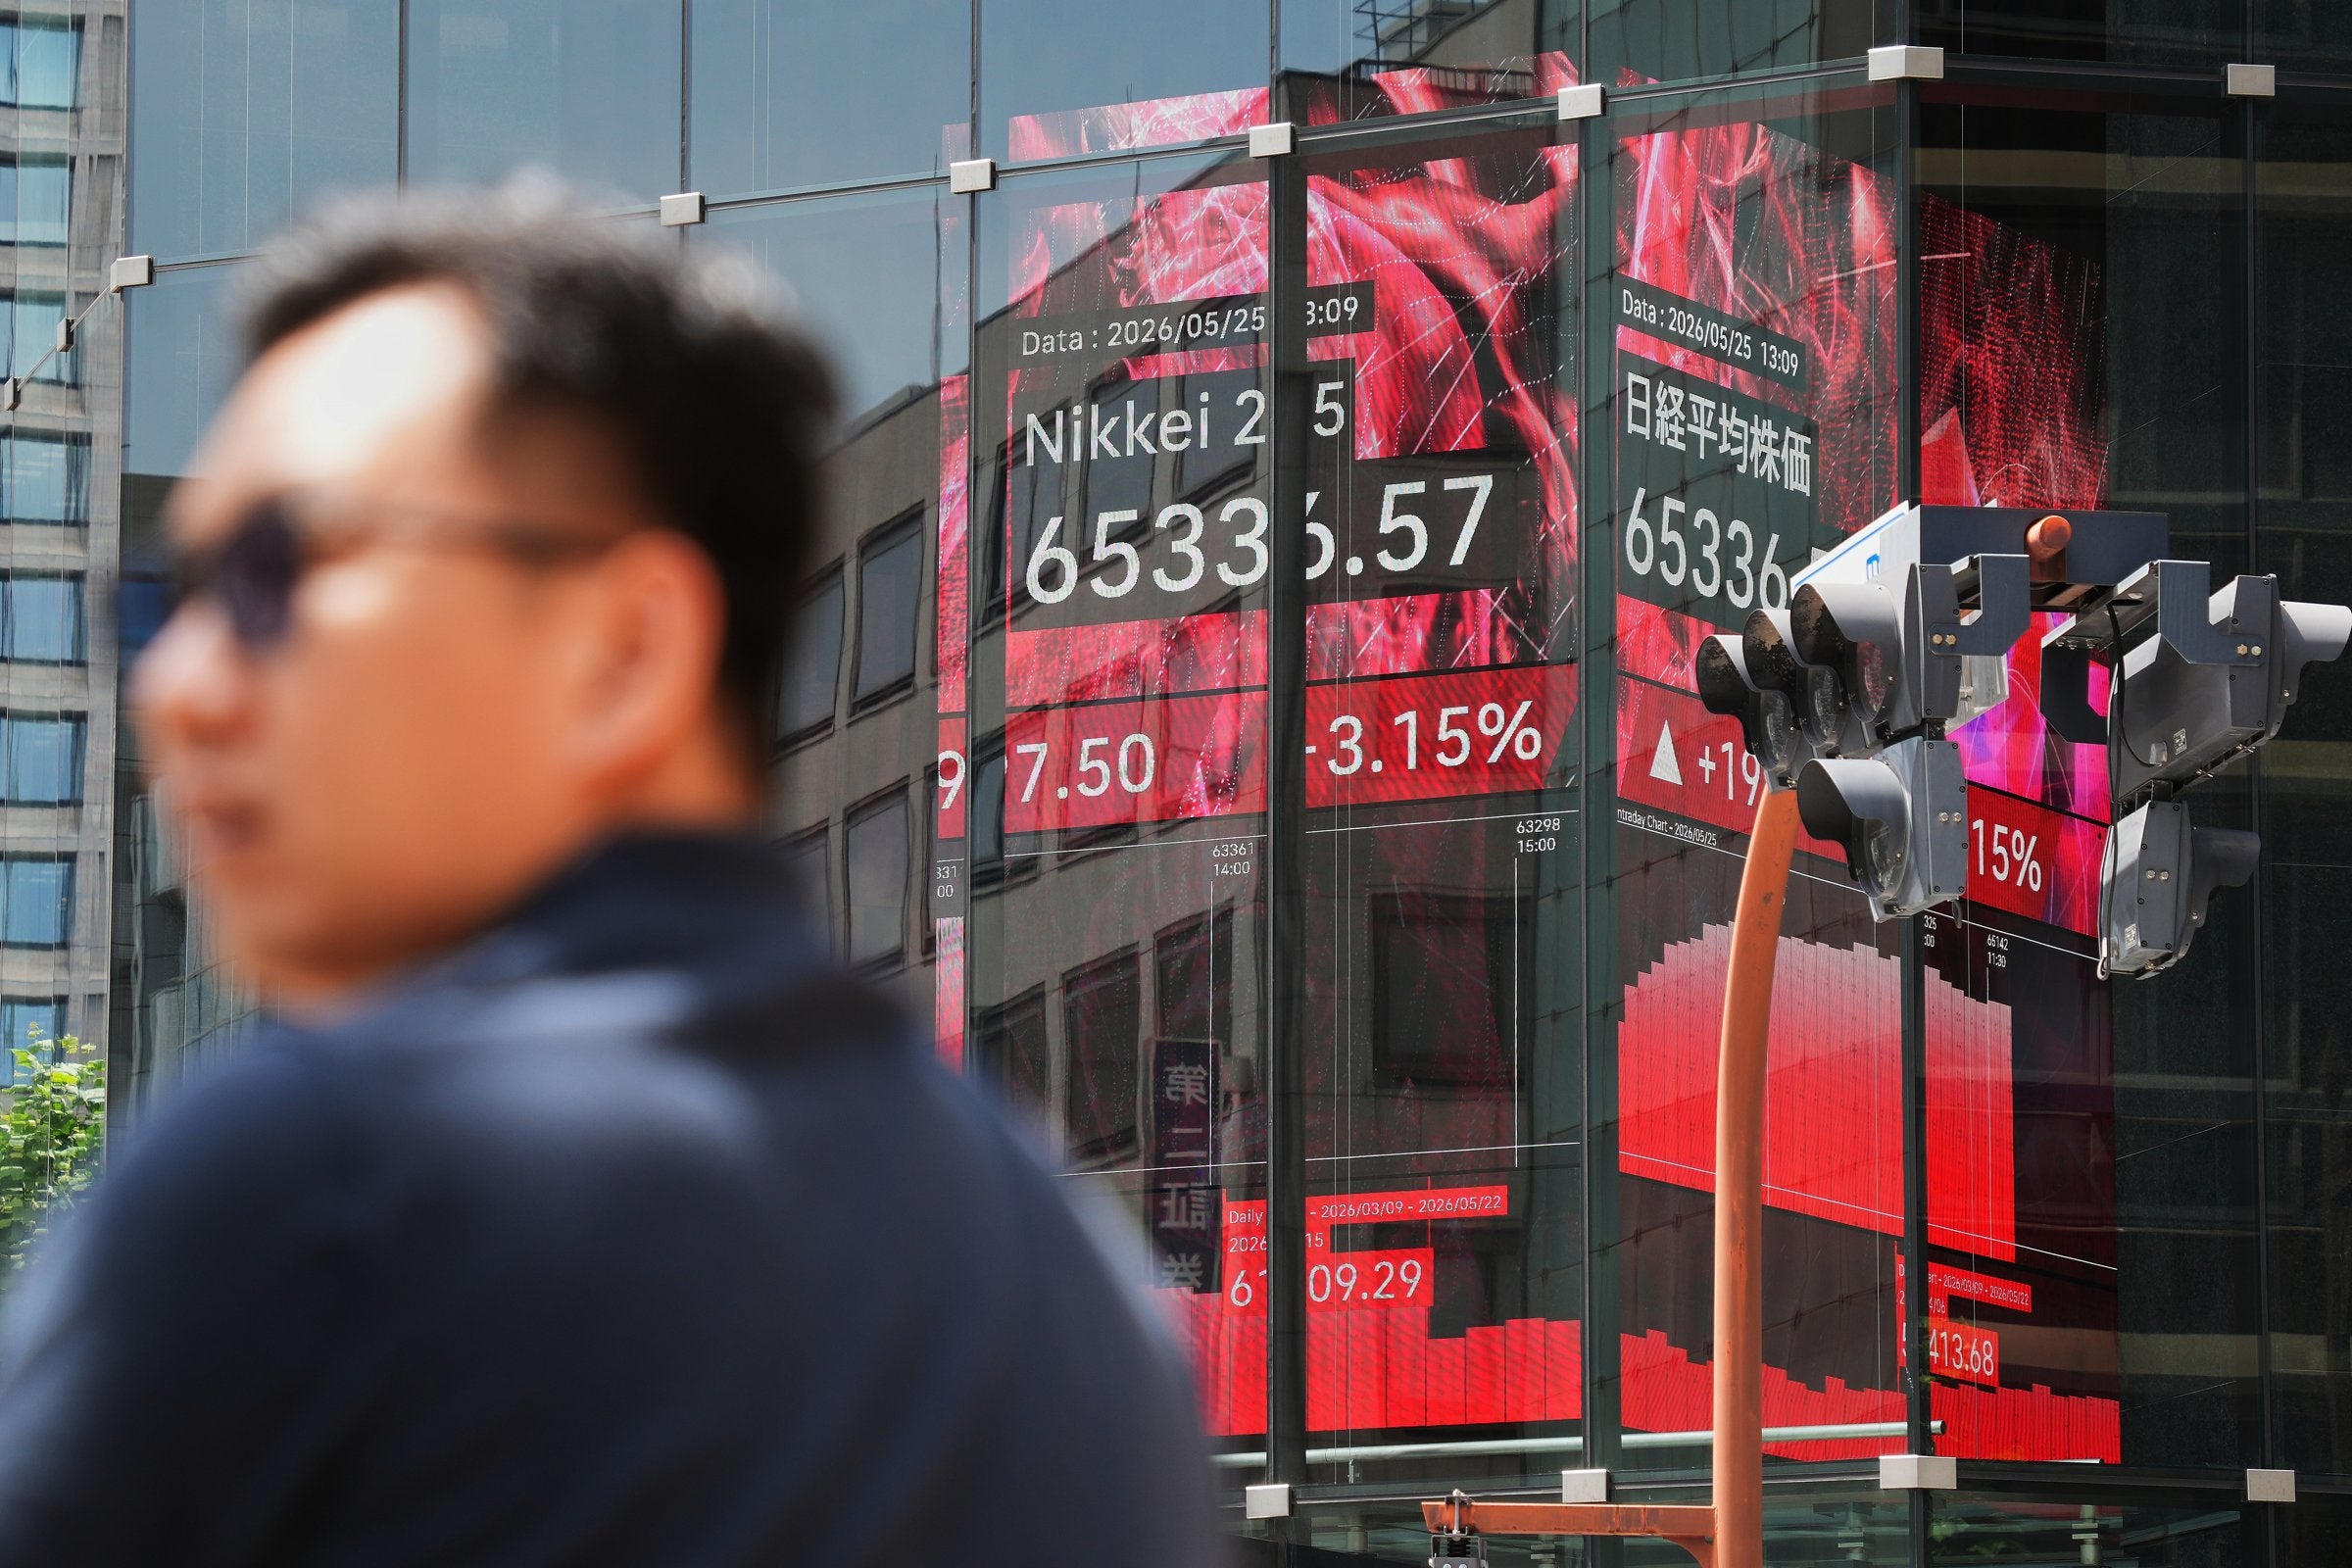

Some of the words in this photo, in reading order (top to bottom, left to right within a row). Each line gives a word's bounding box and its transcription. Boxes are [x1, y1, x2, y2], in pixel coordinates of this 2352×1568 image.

[1107, 306, 1266, 347] 2026/05/25
[1306, 296, 1359, 326] 3:09
[1668, 307, 1752, 360] 2026/05/25
[1761, 341, 1798, 377] 13:09
[1026, 393, 1209, 466] Nikkei
[1234, 380, 1346, 445] 25
[1627, 371, 1812, 497] 日経平均株価
[1026, 474, 1494, 604] 65336.57
[1626, 487, 1829, 610] 65336
[1516, 817, 1561, 834] 63298
[1617, 808, 1646, 828] ntraday
[1647, 814, 1668, 833] Chart
[1674, 823, 1717, 846] 2026/05/25
[1212, 842, 1254, 858] 63361
[1517, 838, 1556, 853] 15:00
[1213, 861, 1250, 877] 14:00
[1986, 933, 2009, 951] 65142
[1987, 952, 2007, 968] 11:30
[1229, 1209, 1264, 1226] Daily
[1321, 1200, 1403, 1218] 2026/03/09
[1418, 1195, 1502, 1213] 2026/05/22
[1230, 1259, 1422, 1307] 609.29
[1943, 1274, 1984, 1294] 2026/03/09
[1989, 1286, 2030, 1306] 2026/05/22
